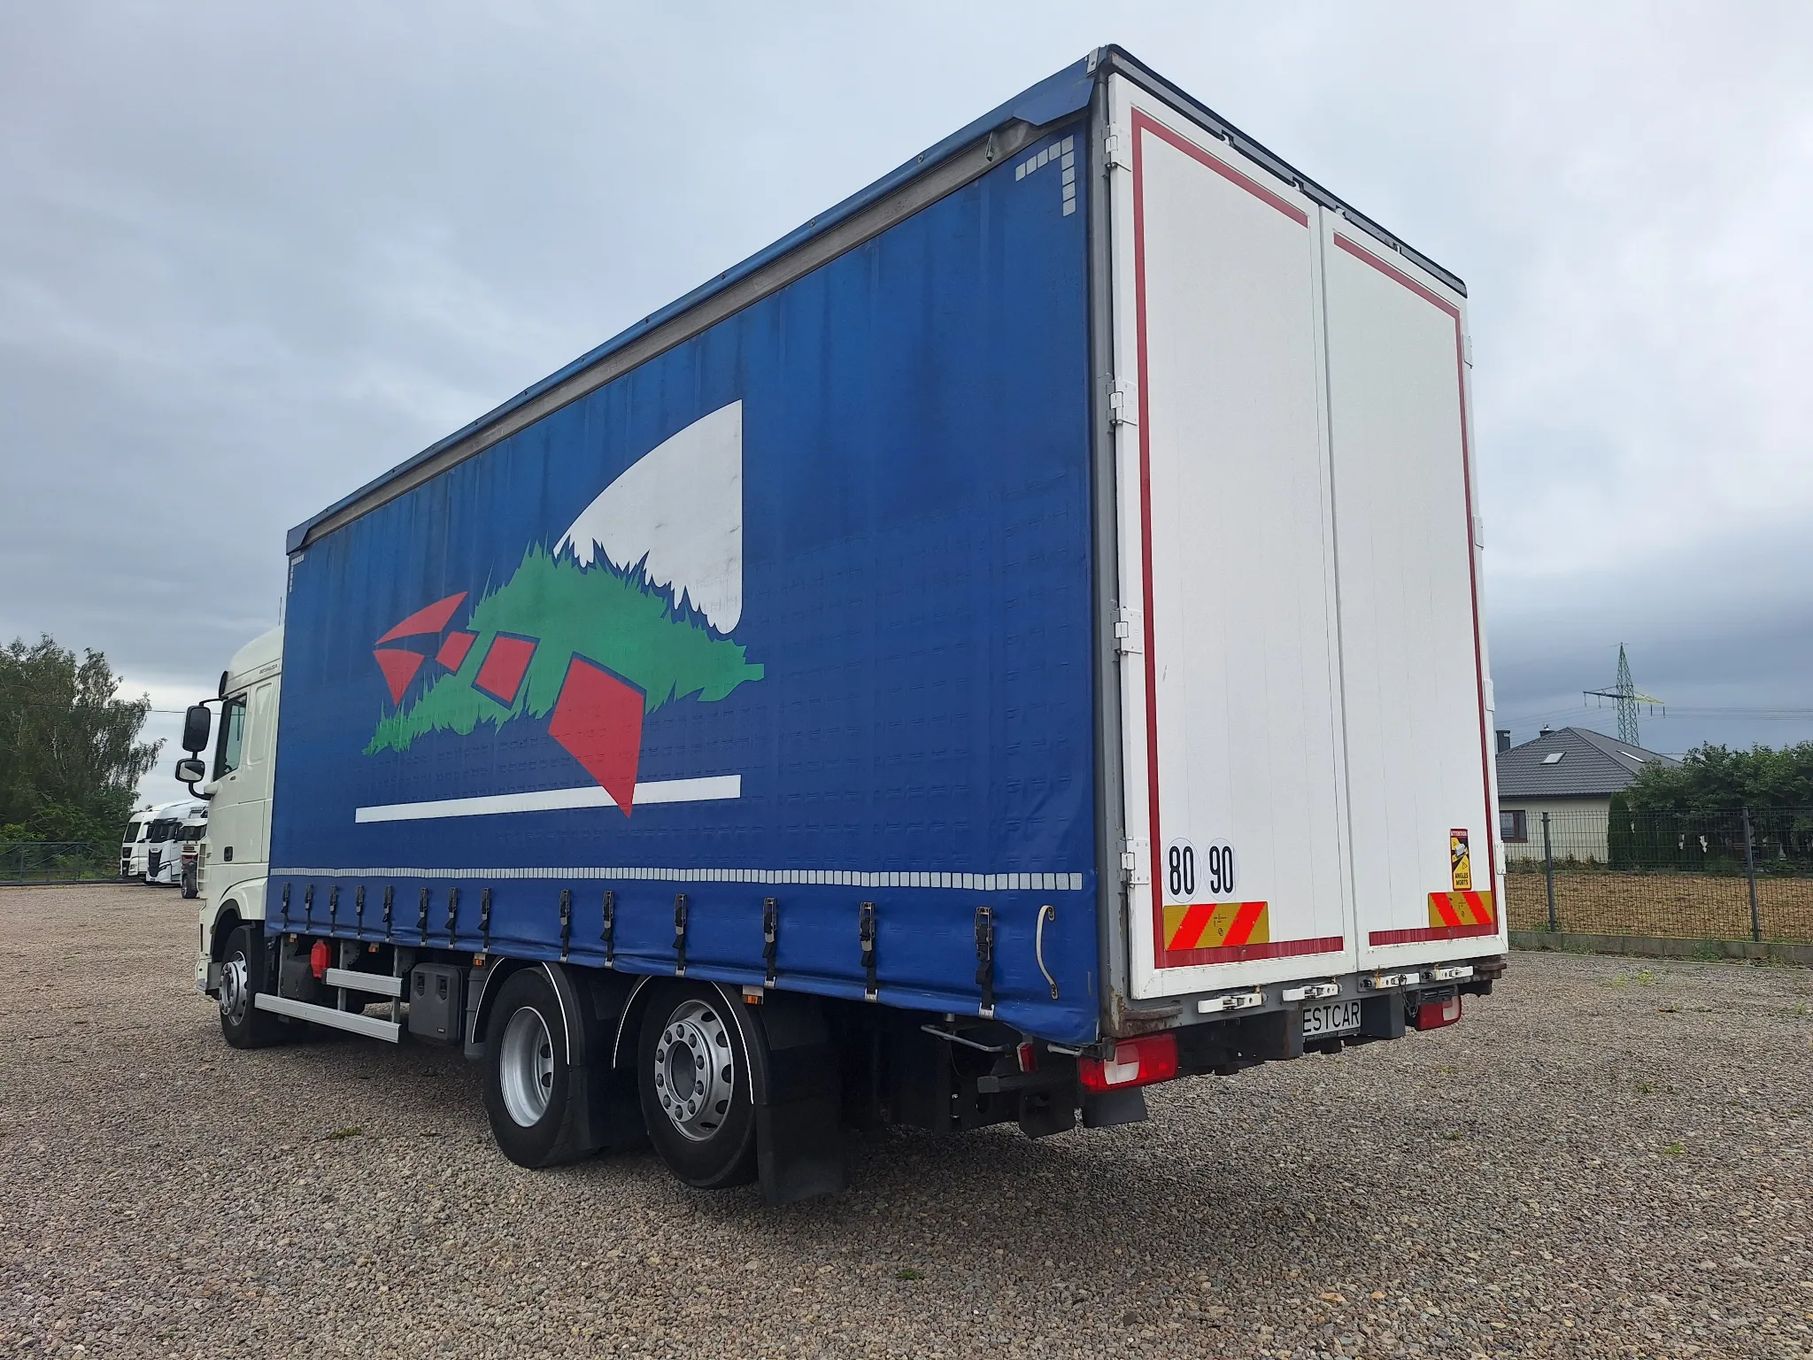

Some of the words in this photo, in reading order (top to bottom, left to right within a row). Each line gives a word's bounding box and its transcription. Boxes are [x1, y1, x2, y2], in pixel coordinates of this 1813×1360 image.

[1169, 846, 1194, 895] 80
[1209, 846, 1233, 894] 90
[1303, 1002, 1359, 1033] ESTCAR
